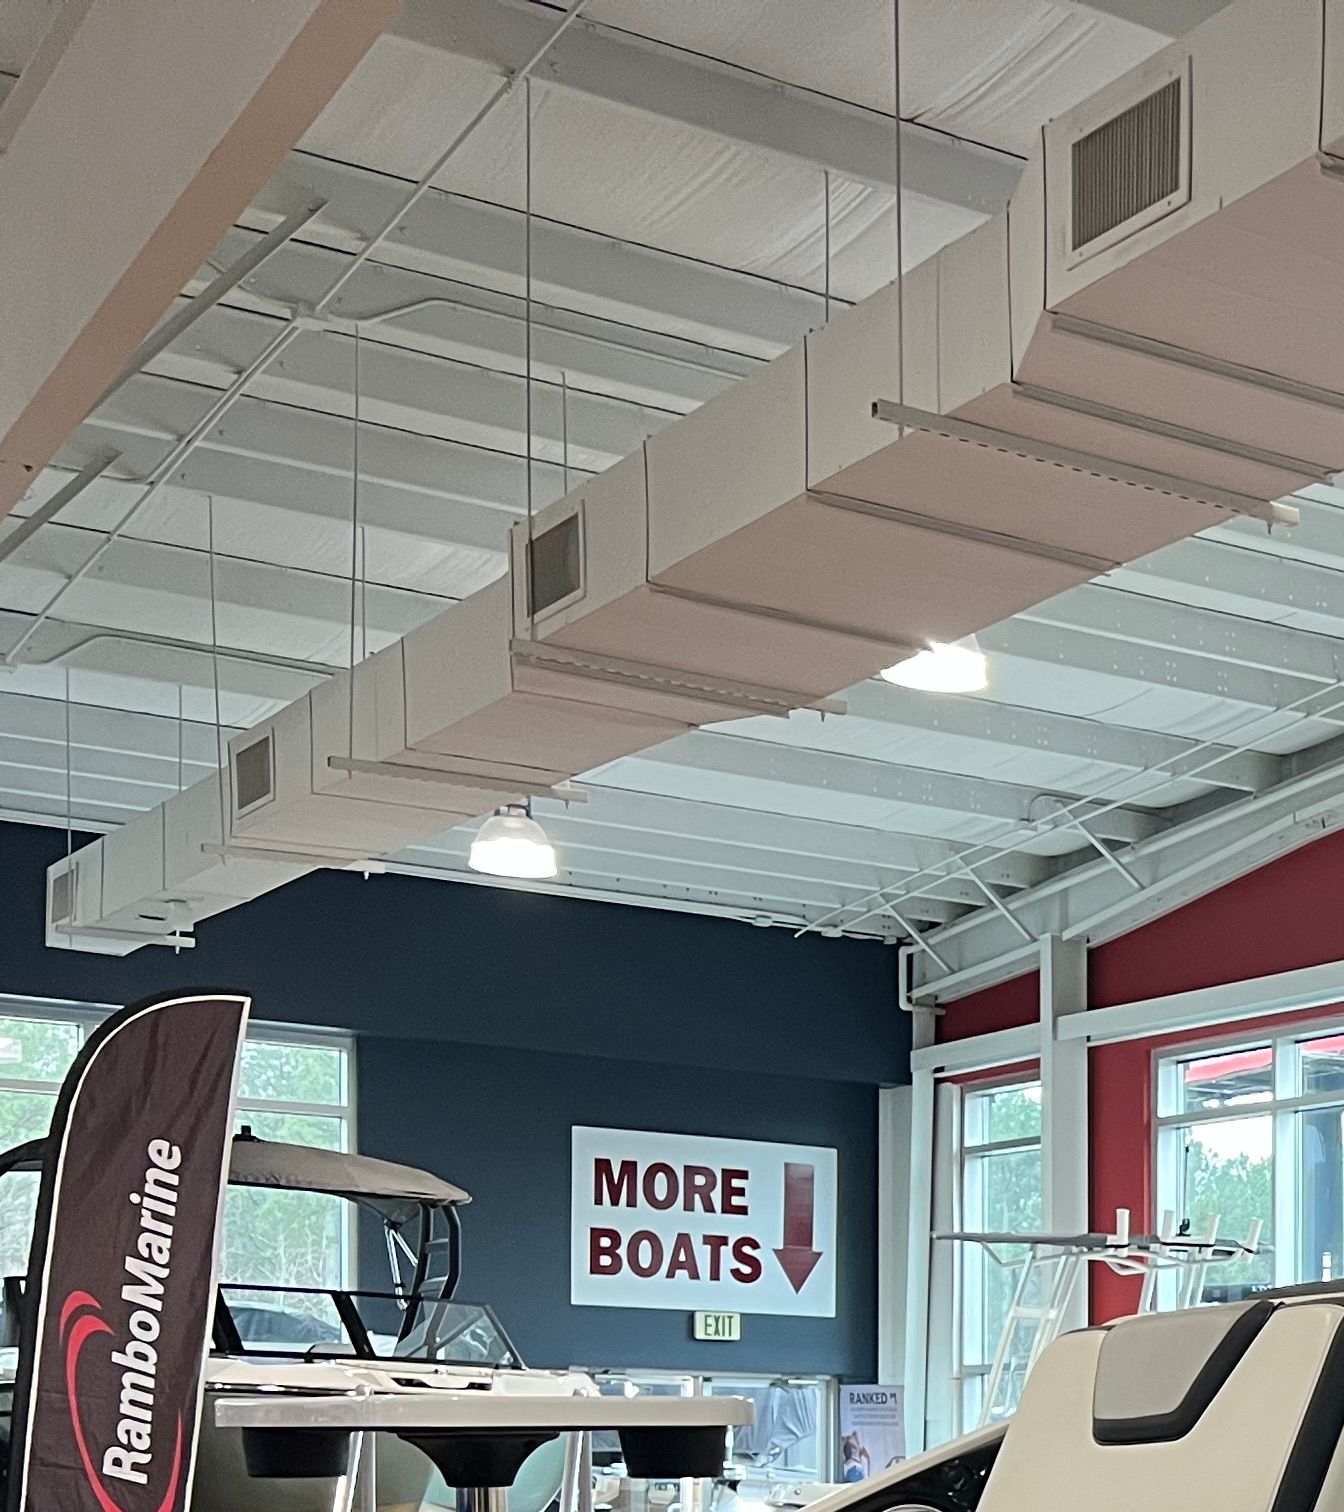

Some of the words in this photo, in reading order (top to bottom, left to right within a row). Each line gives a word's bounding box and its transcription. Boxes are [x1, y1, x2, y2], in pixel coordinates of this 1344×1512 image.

[593, 1157, 750, 1216] MORE
[589, 1226, 763, 1285] BOATS
[101, 1136, 183, 1485] RamboMarine
[703, 1314, 735, 1338] EXIT
[849, 1392, 888, 1405] RANKED
